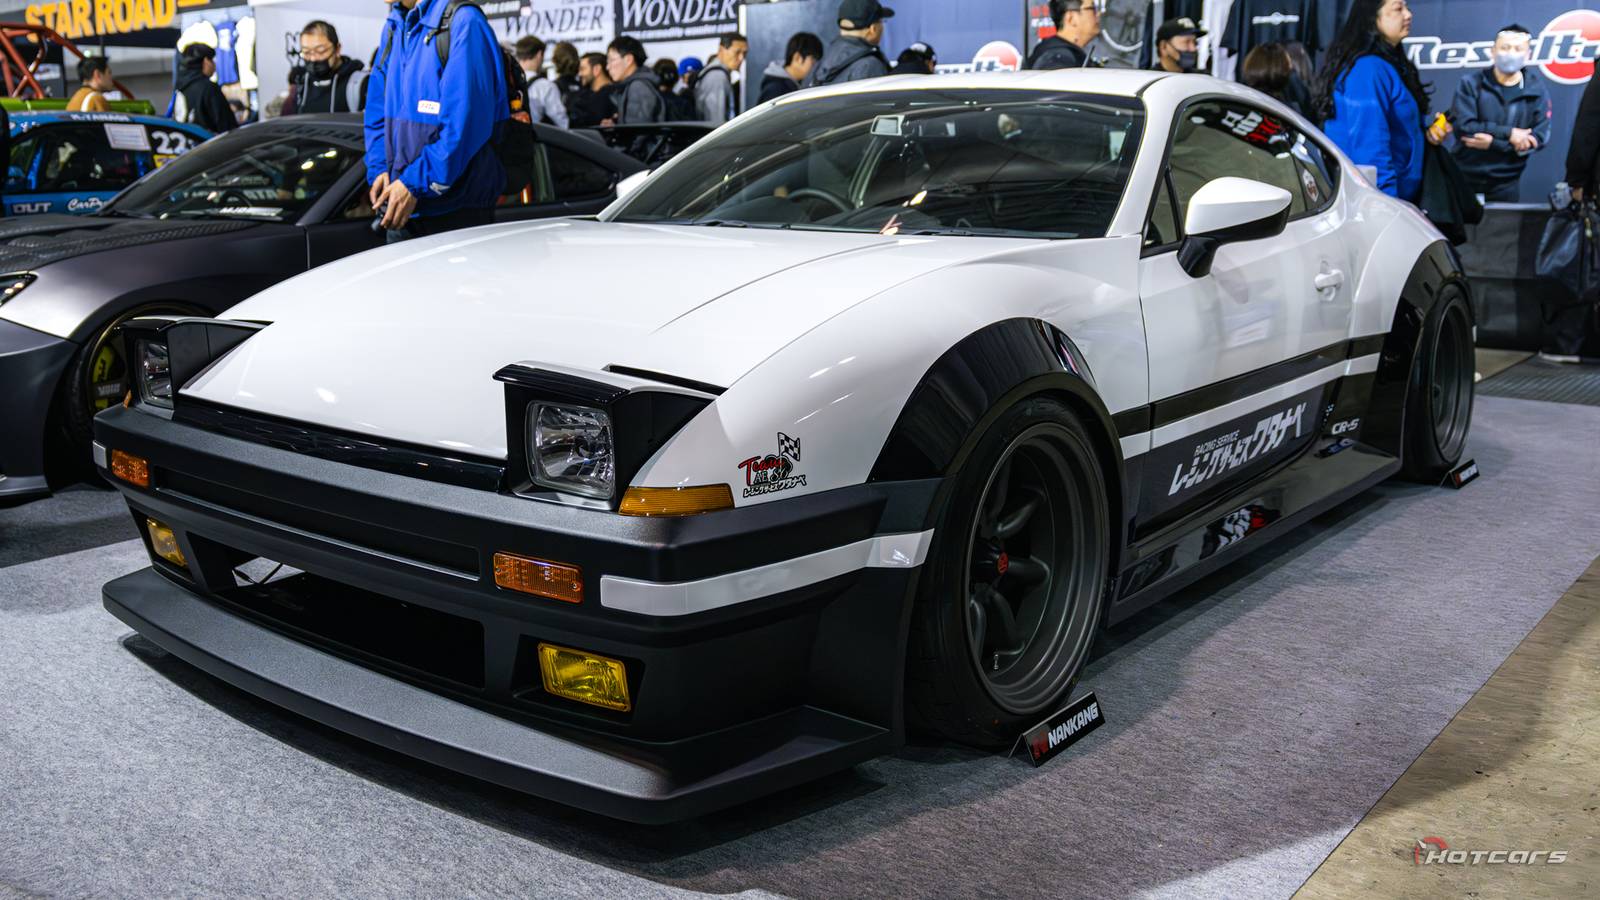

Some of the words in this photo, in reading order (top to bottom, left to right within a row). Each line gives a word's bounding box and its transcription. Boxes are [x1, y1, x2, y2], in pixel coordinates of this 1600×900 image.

[25, 0, 95, 43] STAR
[95, 0, 178, 35] ROAD
[504, 5, 605, 35] WONDER
[621, 0, 738, 28] WONDER
[1402, 30, 1600, 69] Reslt
[1331, 418, 1360, 435] CR-S
[738, 455, 786, 486] Team
[1048, 701, 1099, 749] NANKANG
